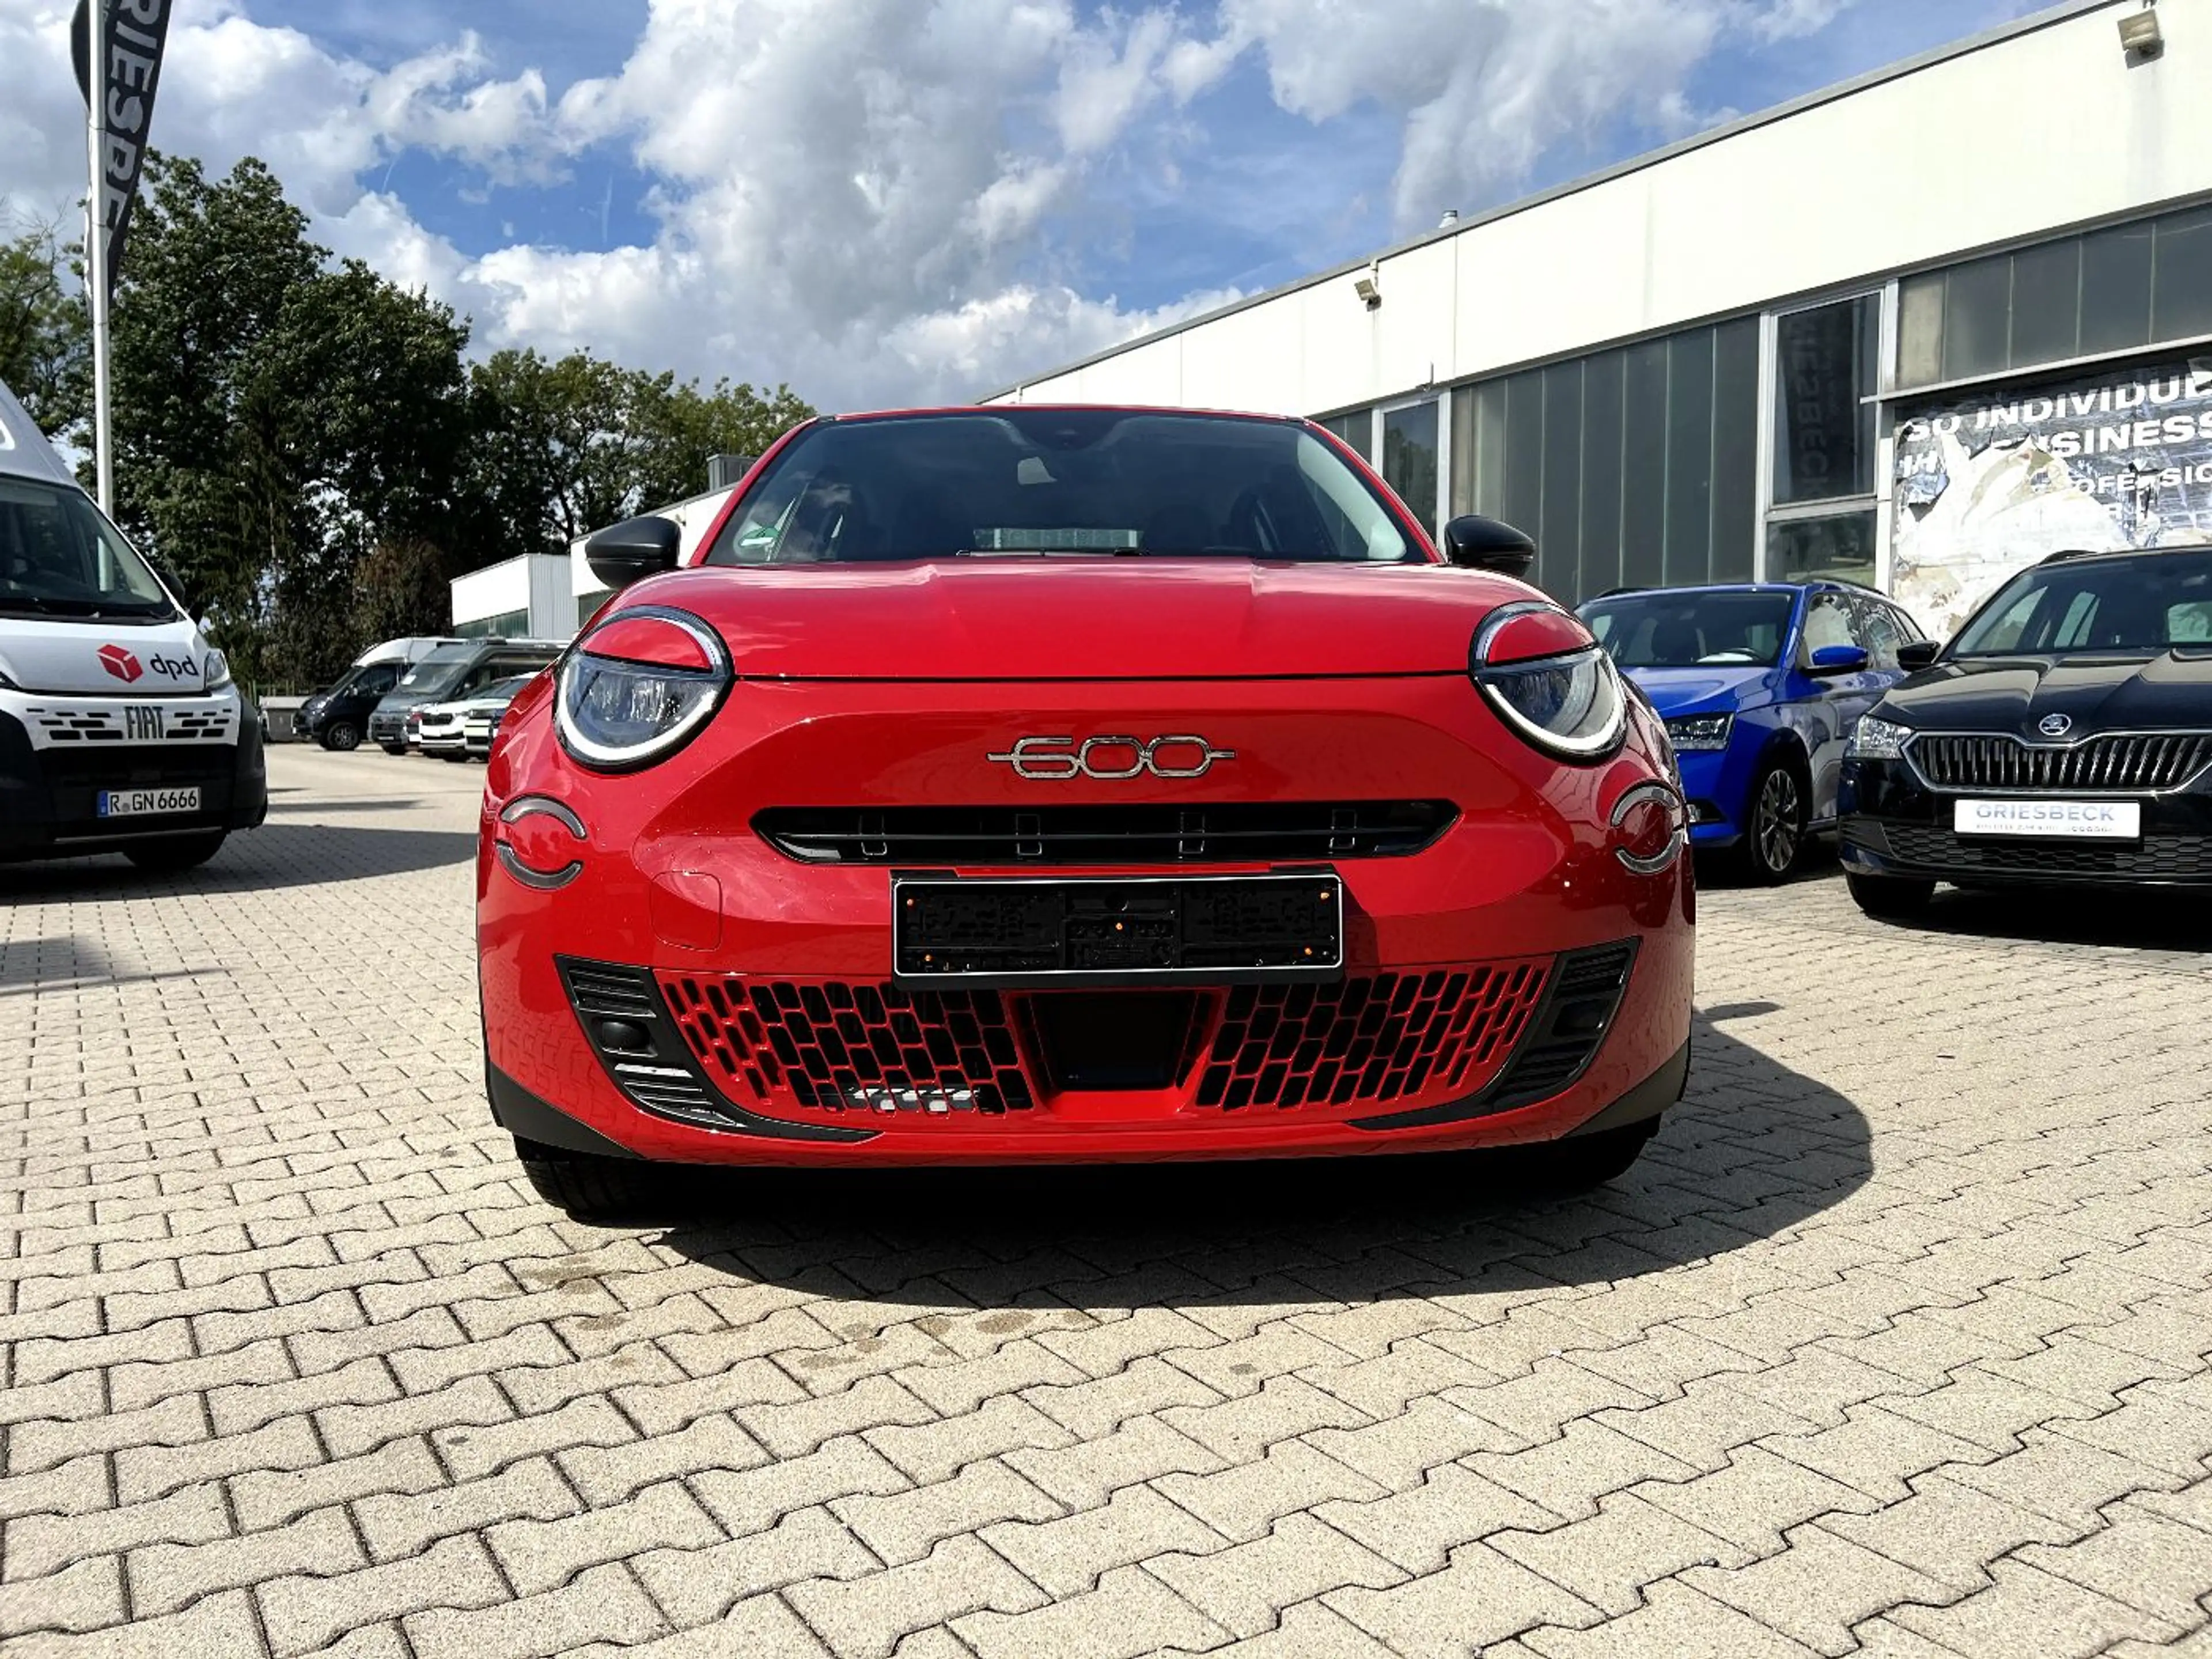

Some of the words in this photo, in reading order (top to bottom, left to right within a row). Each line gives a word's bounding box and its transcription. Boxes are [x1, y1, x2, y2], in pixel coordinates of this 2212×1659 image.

[150, 653, 199, 681] dpd
[124, 706, 164, 739] FIAT
[987, 734, 1235, 779] 600
[110, 794, 120, 813] R
[132, 793, 154, 811] GN
[158, 790, 196, 809] 6666
[1976, 804, 2115, 821] GRIESBECK
